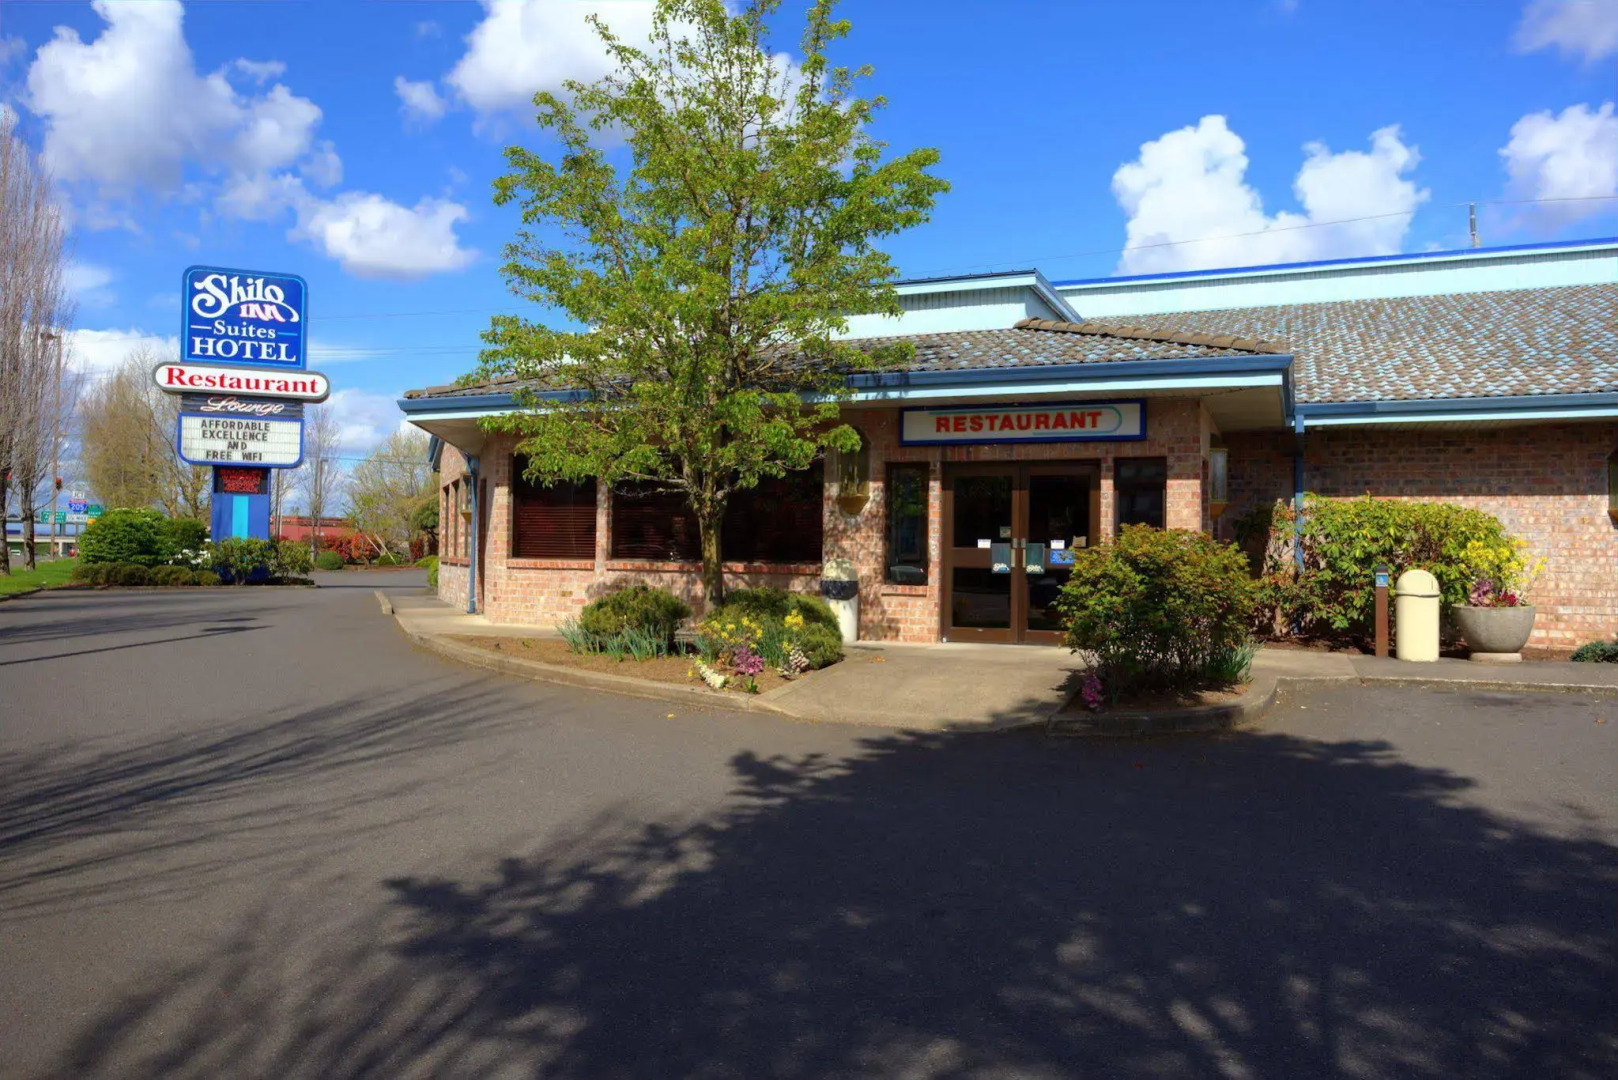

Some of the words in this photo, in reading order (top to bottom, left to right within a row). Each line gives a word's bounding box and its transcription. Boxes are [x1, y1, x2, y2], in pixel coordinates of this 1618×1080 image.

[192, 274, 299, 322] Shilo
[213, 320, 276, 338] Suites
[191, 337, 296, 362] HOTEL
[165, 367, 319, 393] Restaurant
[201, 420, 270, 431] AFFORDABLE
[935, 411, 1103, 432] RESTAURANT
[202, 430, 267, 441] EXCELLENCE
[227, 441, 247, 451] AND
[206, 451, 232, 461] FREE
[243, 451, 263, 462] WIFI
